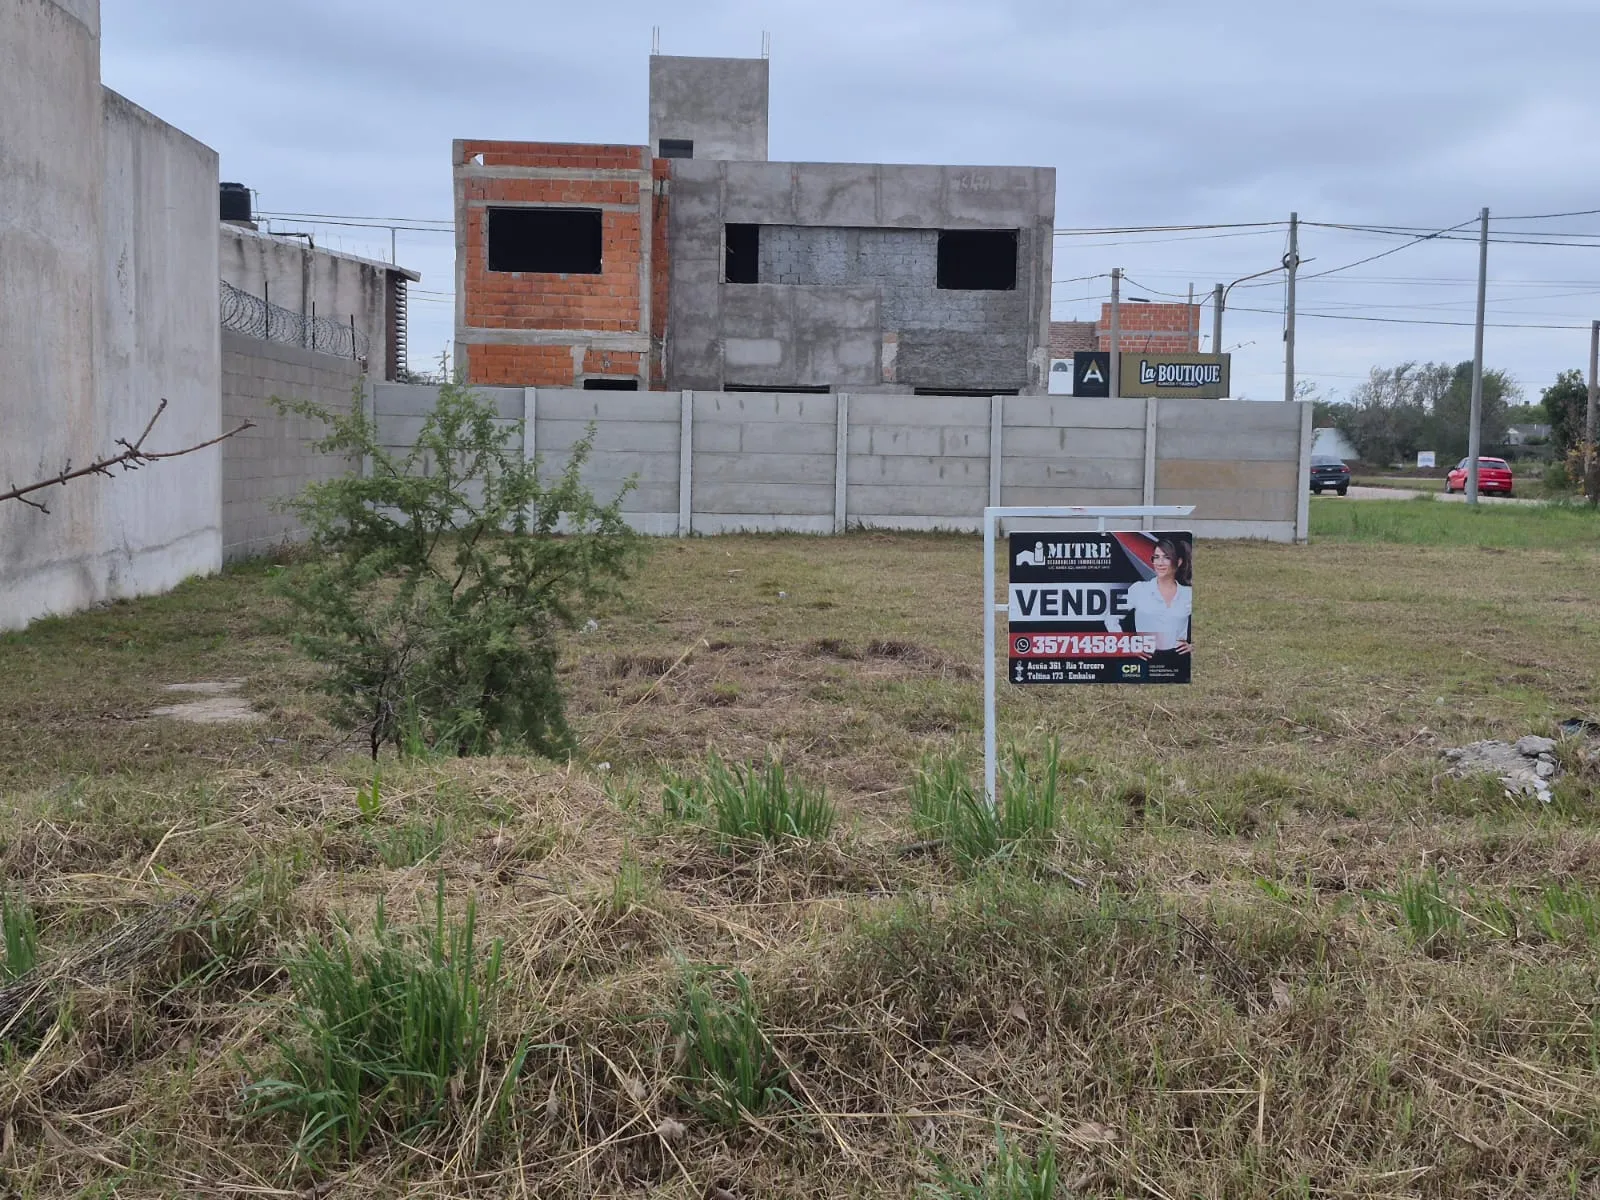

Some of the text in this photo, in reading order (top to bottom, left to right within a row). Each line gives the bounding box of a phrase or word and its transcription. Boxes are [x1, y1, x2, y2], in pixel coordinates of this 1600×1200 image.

[1082, 359, 1104, 383] A
[1141, 361, 1220, 385] La BOUTIQUE
[1047, 542, 1112, 558] MITRE
[1015, 589, 1130, 616] VENDE
[1032, 635, 1157, 654] 3571458465
[1078, 661, 1105, 670] Tercero
[1121, 664, 1141, 674] CPI
